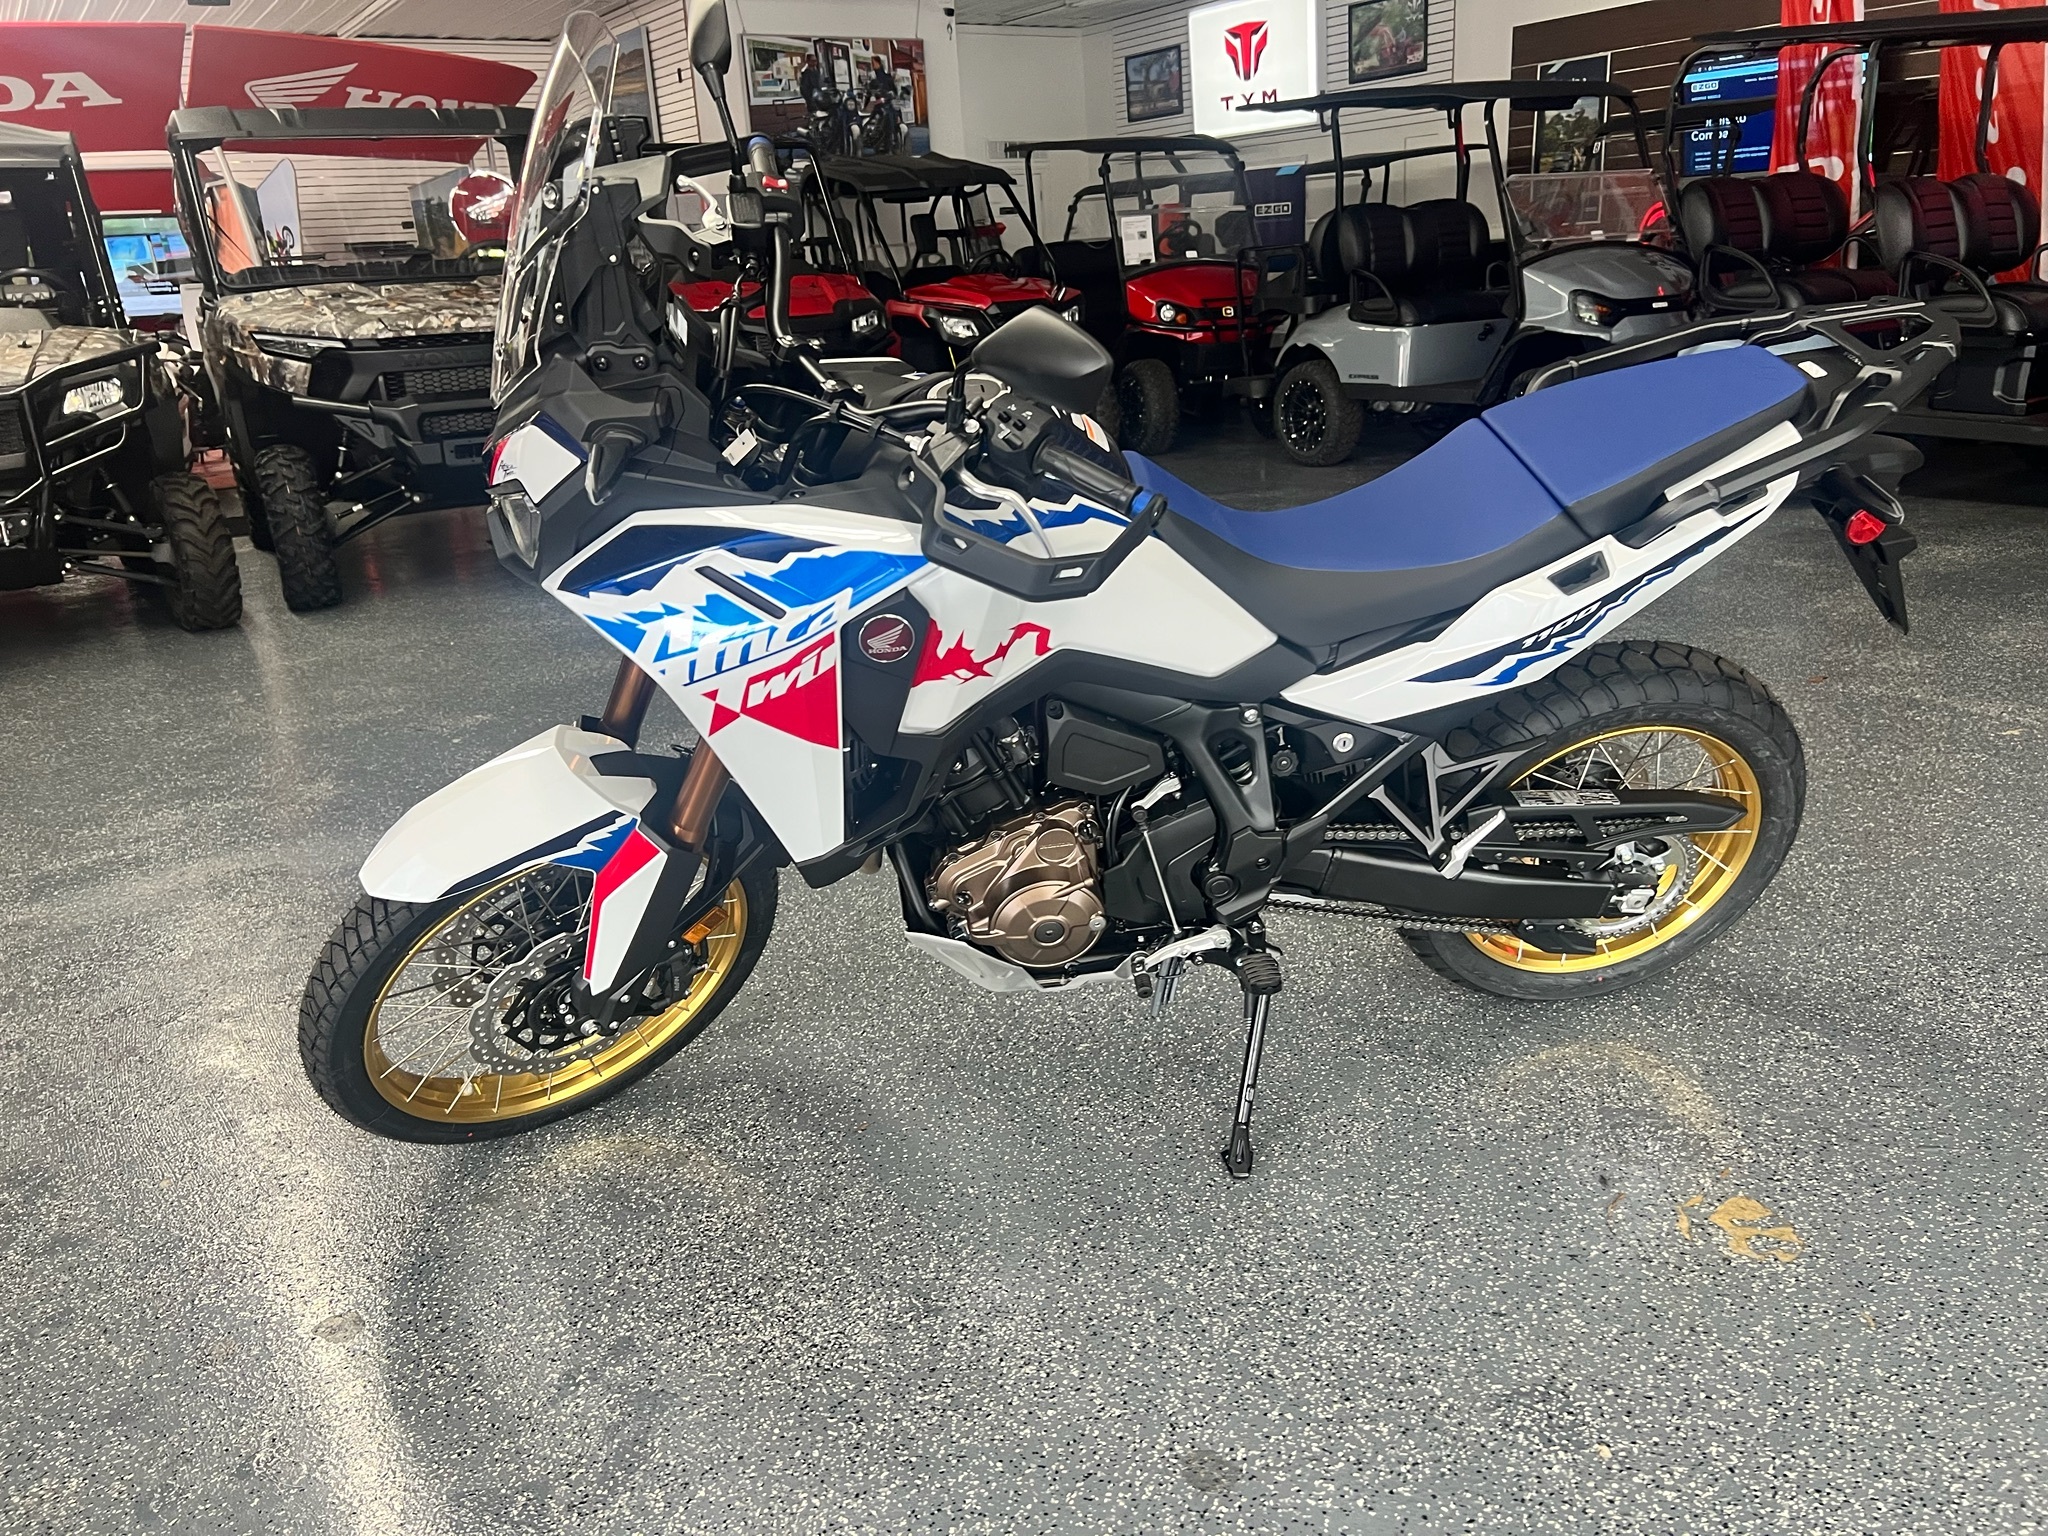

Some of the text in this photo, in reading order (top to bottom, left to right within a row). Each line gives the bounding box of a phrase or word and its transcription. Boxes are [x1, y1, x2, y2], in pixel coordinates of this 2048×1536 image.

[1220, 88, 1278, 111] TYM
[1256, 203, 1290, 215] EZGO
[1521, 600, 1602, 650] 1100
[868, 645, 908, 654] HONDA
